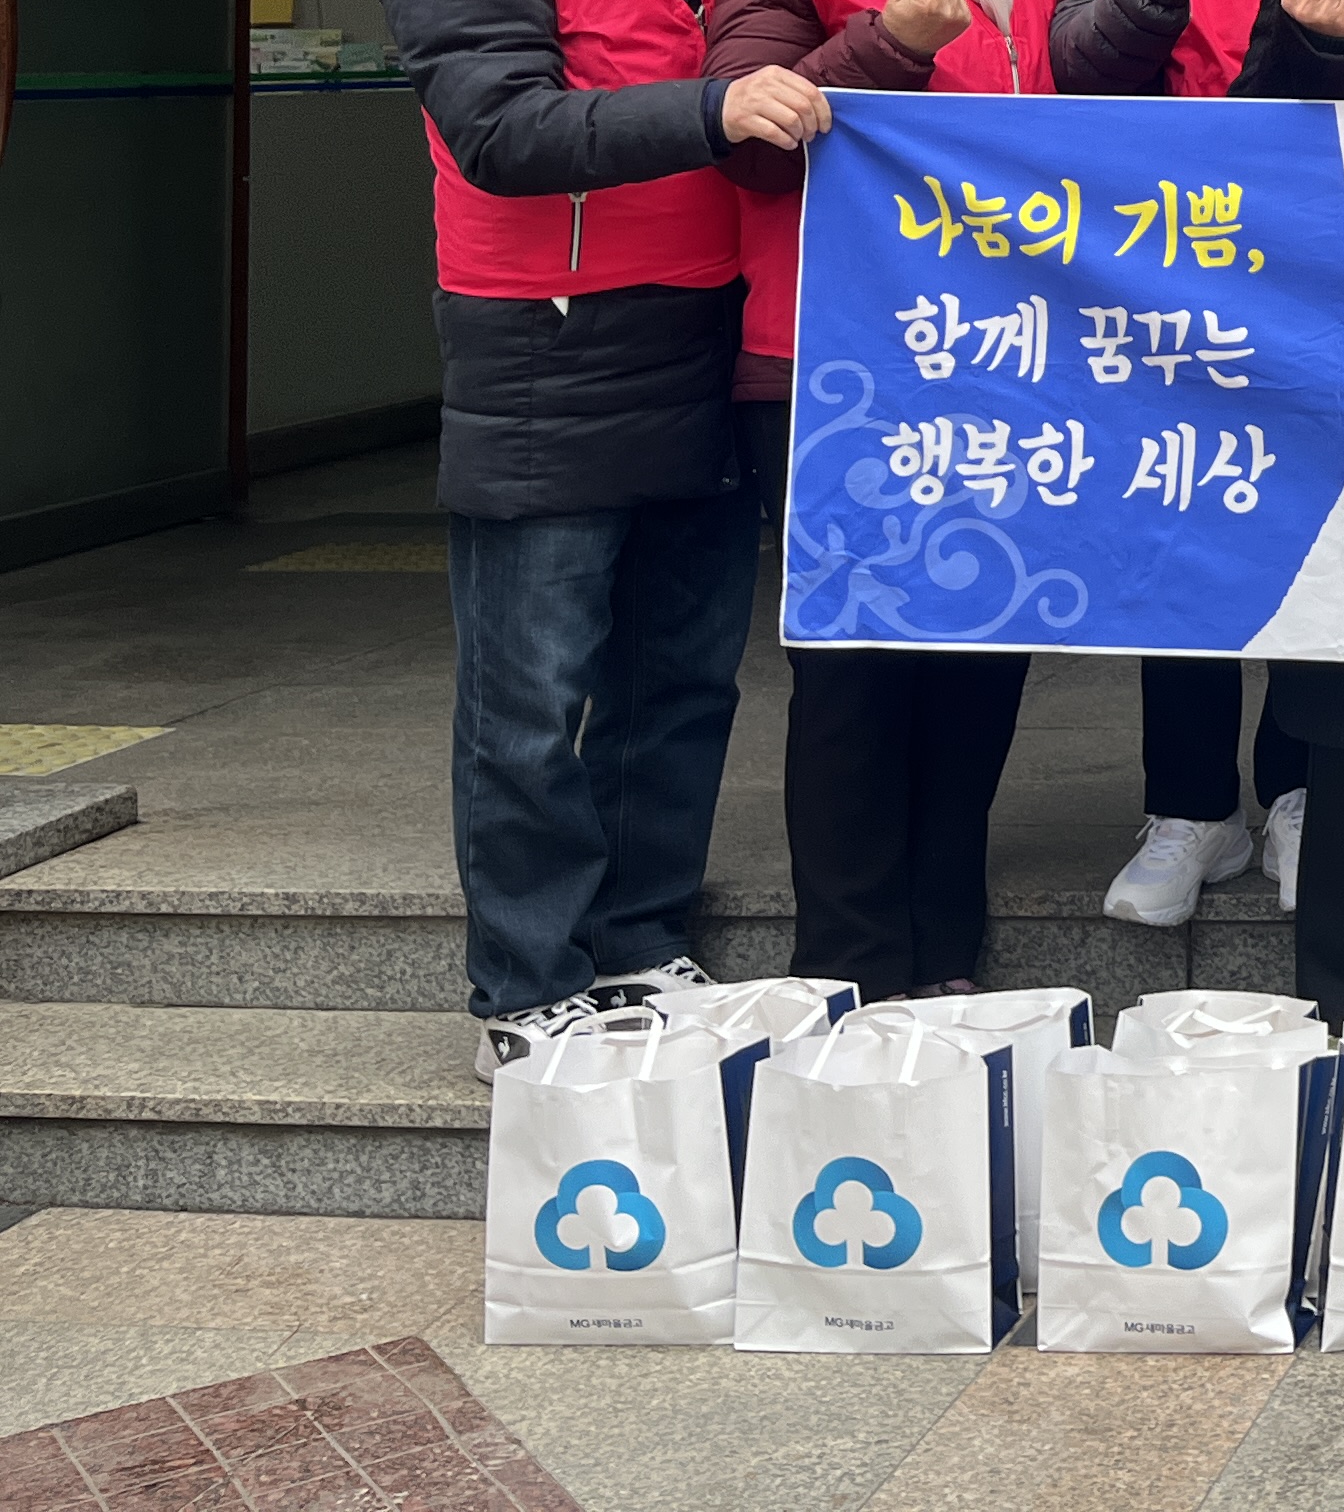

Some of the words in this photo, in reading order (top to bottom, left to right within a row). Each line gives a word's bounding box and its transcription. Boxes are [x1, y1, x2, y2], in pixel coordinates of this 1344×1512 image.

[893, 176, 1080, 264] 나눔의
[1113, 180, 1265, 273] 기쁨,
[894, 292, 1049, 383] 함께
[1078, 305, 1256, 389] 꿈꾸는
[881, 419, 1095, 508] 행복한
[1123, 422, 1276, 515] 세상
[569, 1318, 643, 1330] MG새마을금고
[824, 1316, 895, 1333] MG새마을금고
[1124, 1321, 1196, 1335] MG새마을금고
